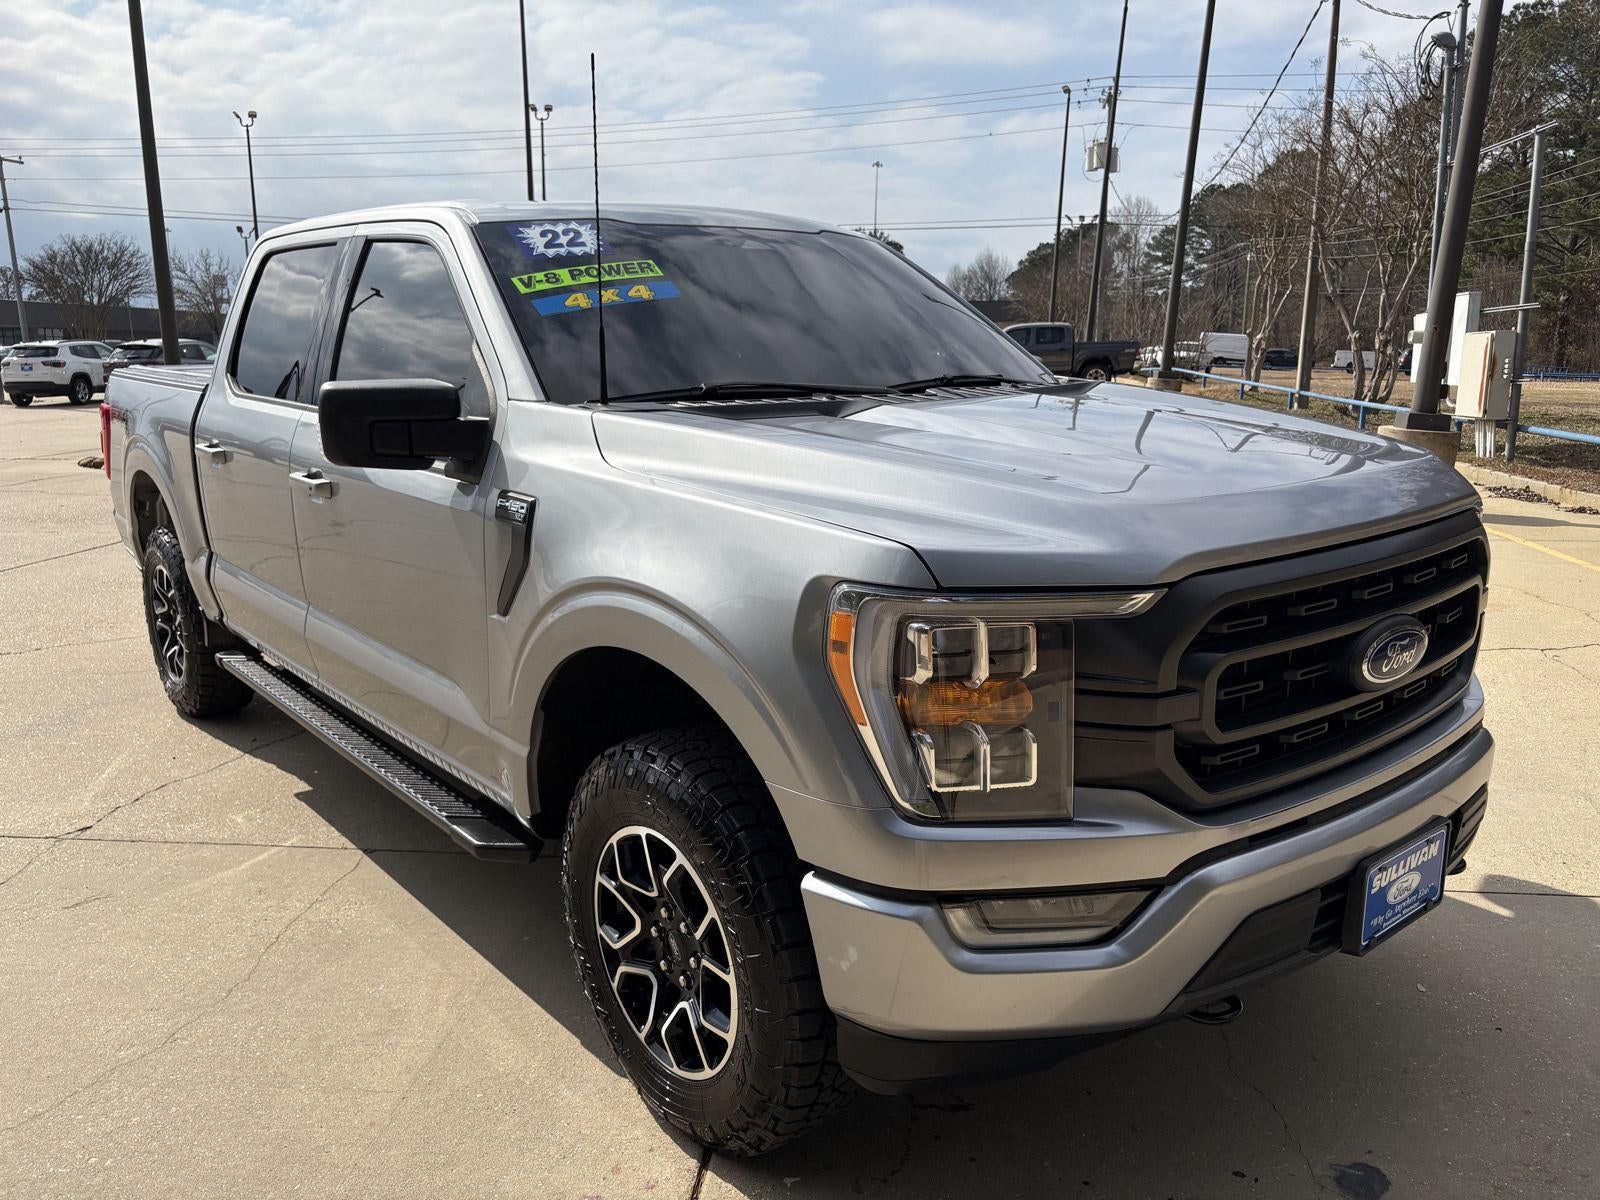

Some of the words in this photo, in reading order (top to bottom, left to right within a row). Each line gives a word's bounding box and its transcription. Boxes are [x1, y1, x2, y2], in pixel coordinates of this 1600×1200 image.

[539, 228, 588, 250] 22
[517, 272, 563, 289] V-8
[568, 261, 657, 281] POWER
[497, 498, 528, 514] F-150
[1382, 637, 1418, 673] Ford
[1371, 840, 1440, 894] SULLIVAN
[1393, 877, 1415, 900] Ford
